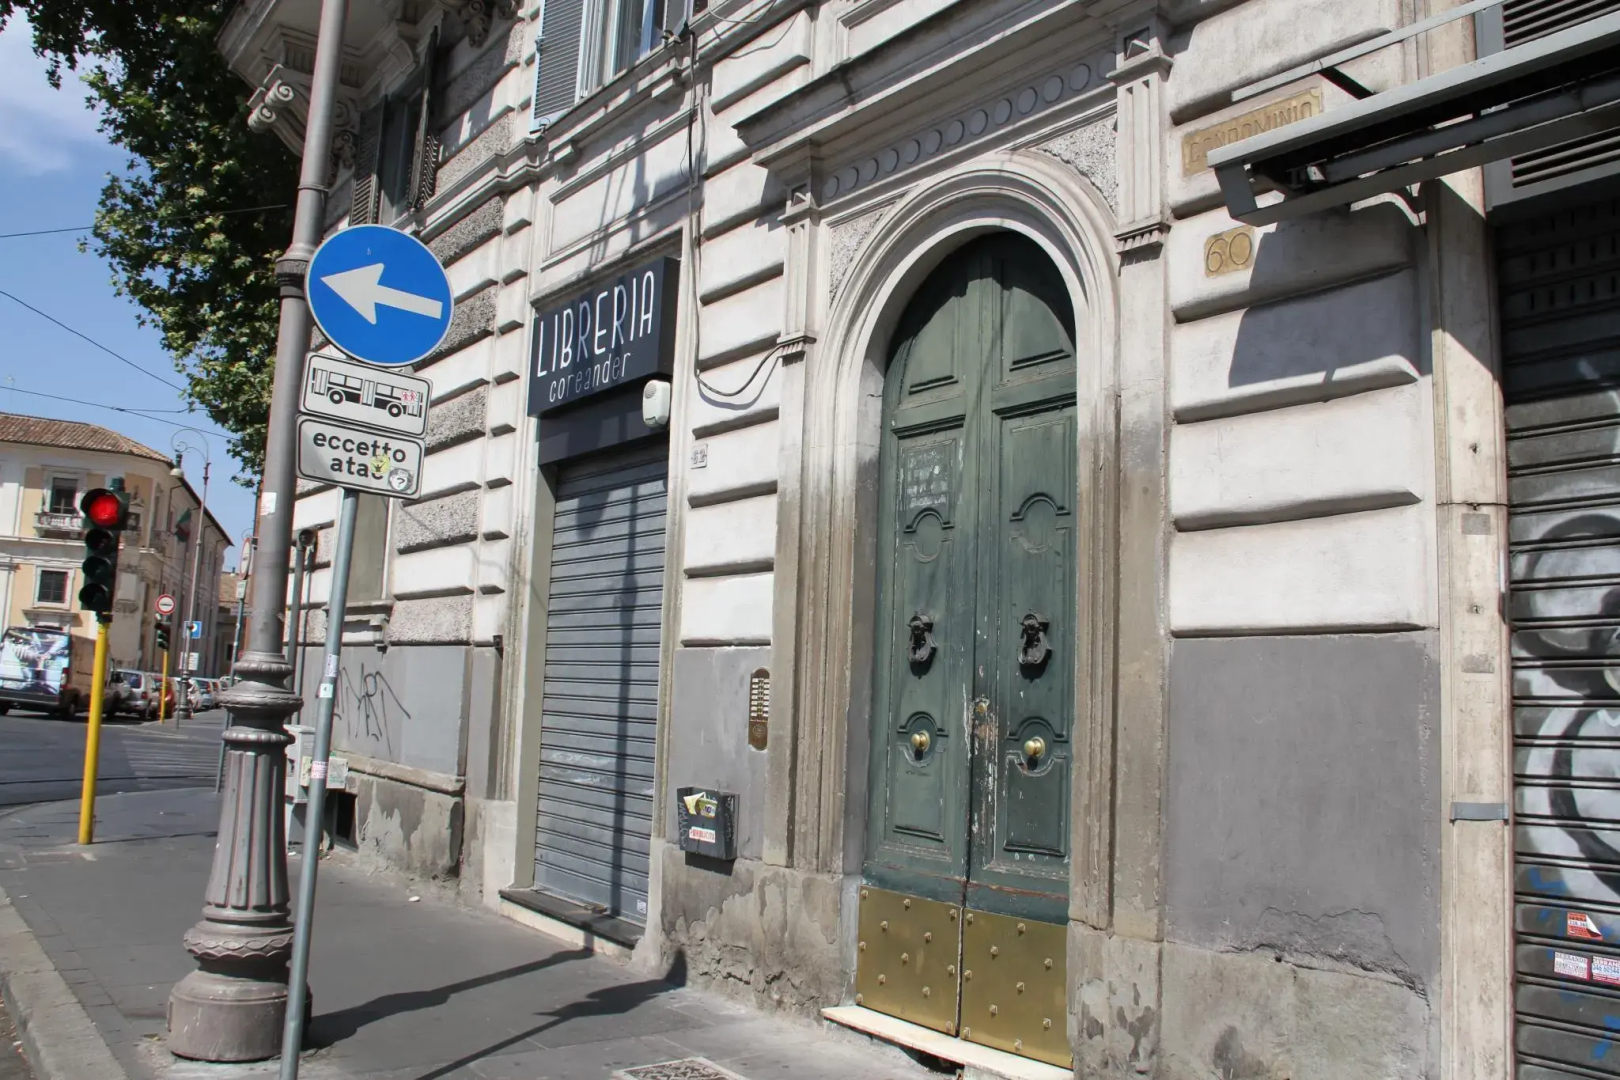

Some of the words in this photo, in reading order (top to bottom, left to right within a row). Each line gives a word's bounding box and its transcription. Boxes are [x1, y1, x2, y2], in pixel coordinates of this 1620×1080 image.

[1206, 232, 1253, 273] 60
[536, 270, 656, 378] LIBRERIA
[549, 353, 632, 403] coreander
[312, 432, 407, 463] eccetto
